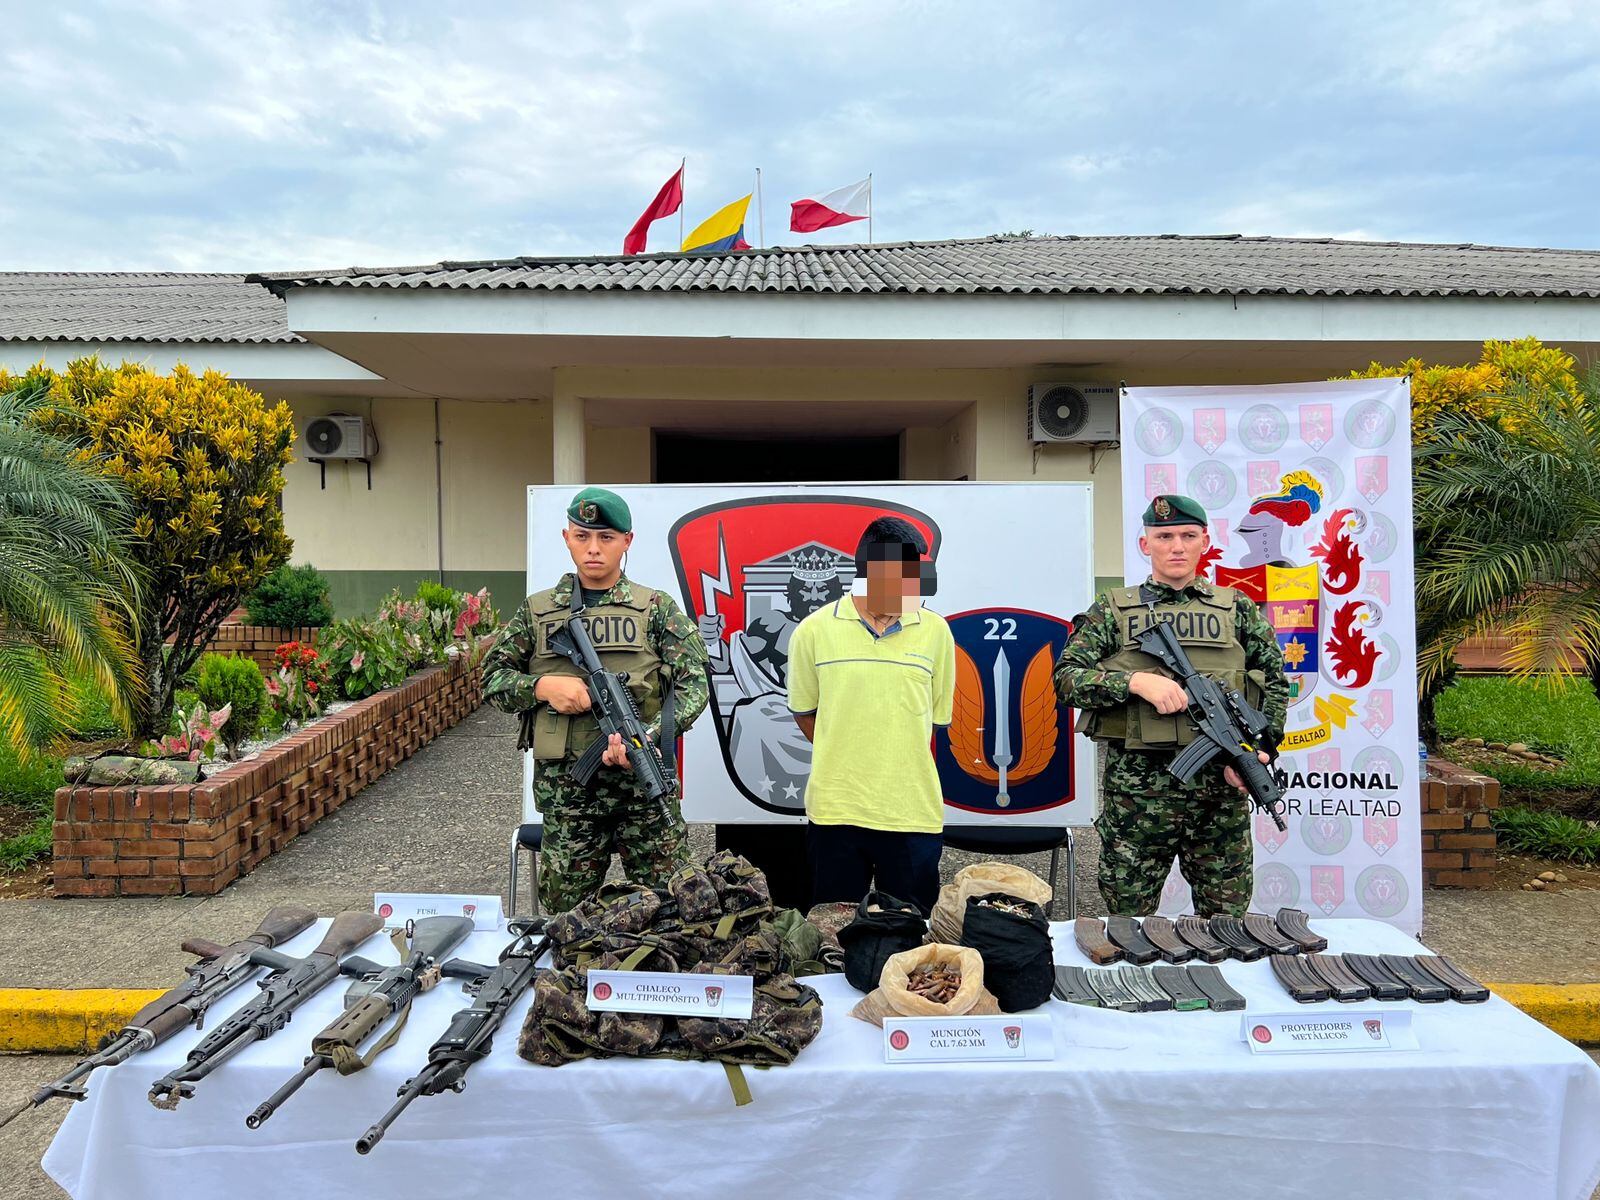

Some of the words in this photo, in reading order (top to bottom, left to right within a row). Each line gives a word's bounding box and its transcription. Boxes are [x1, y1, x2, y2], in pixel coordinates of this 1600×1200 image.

[983, 618, 1018, 640] 22
[1287, 728, 1326, 745] LEALTAD
[1309, 798, 1401, 817] LEALTAD
[636, 984, 681, 993] CHALECO
[616, 992, 700, 1004] MULTIPROPÓSITO
[930, 1027, 981, 1038] MUNICIÓN
[1281, 1022, 1353, 1032] PROVEEDORES
[1291, 1030, 1348, 1040] METÁLICOS
[930, 1039, 949, 1047] CAL
[951, 1039, 967, 1047] 7.62
[969, 1039, 986, 1047] MM
